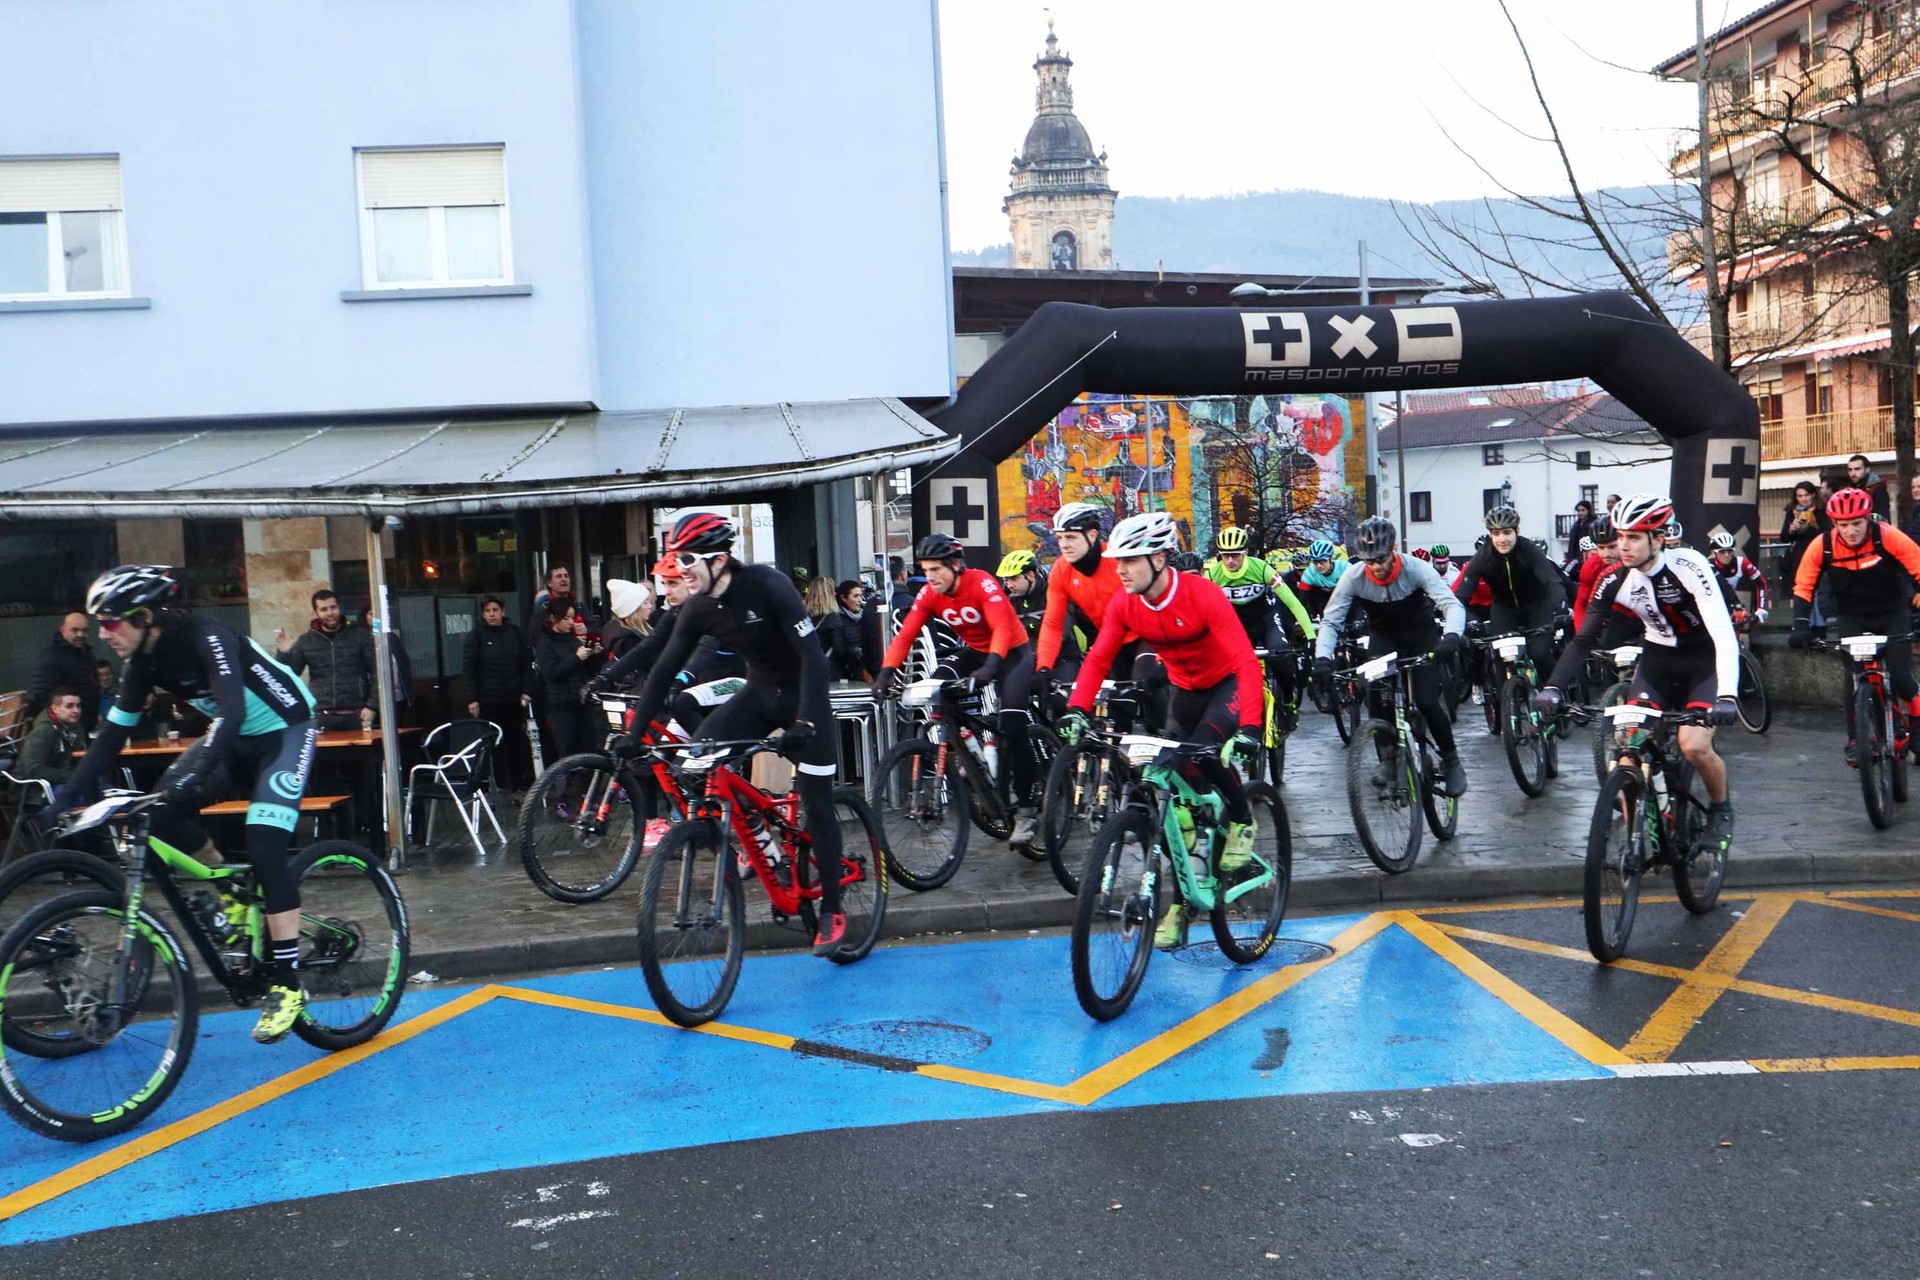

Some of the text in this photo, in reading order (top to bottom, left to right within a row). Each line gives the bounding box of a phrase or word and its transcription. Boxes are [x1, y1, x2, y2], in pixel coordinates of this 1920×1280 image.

[1245, 363, 1459, 382] maspormenos
[1227, 585, 1264, 600] EZO
[942, 606, 981, 626] GO
[206, 635, 232, 676] ZAIKLIN
